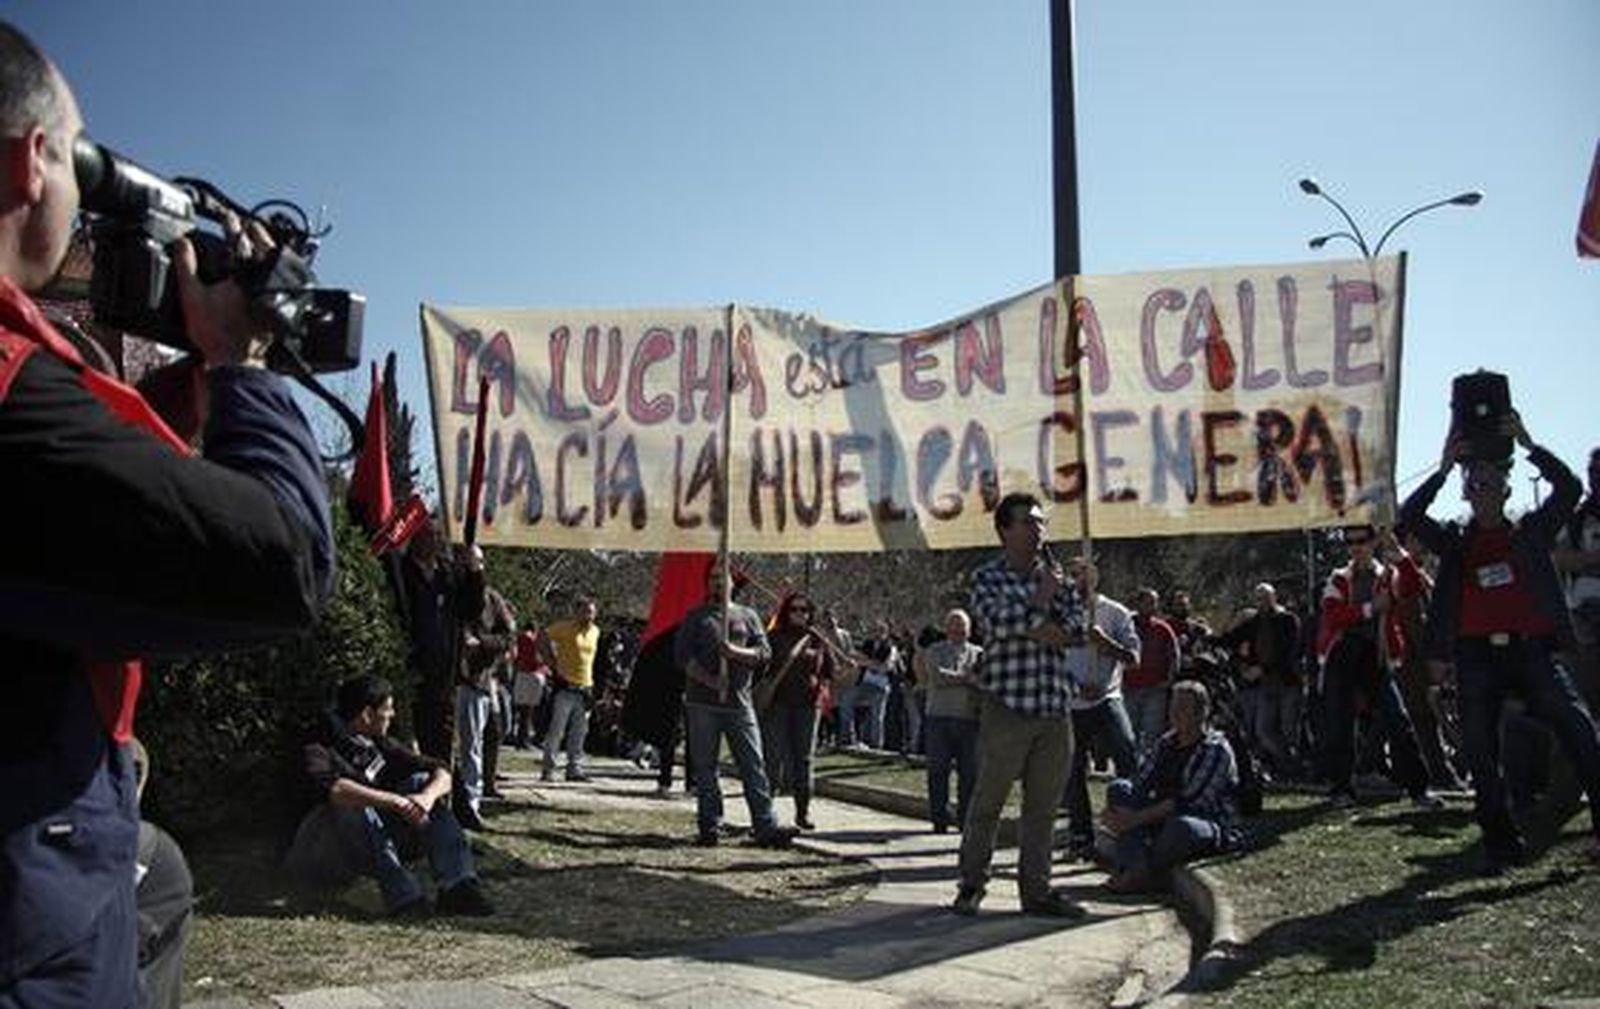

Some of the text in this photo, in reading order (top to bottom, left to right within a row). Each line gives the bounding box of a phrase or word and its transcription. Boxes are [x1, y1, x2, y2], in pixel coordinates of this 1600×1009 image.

[452, 328, 516, 418] LA
[546, 323, 766, 425] LUCHA
[899, 313, 1006, 402] EN
[1039, 296, 1110, 396] LA
[1141, 275, 1386, 393] CALLE
[673, 434, 726, 530] LA
[749, 419, 999, 533] HUELGA
